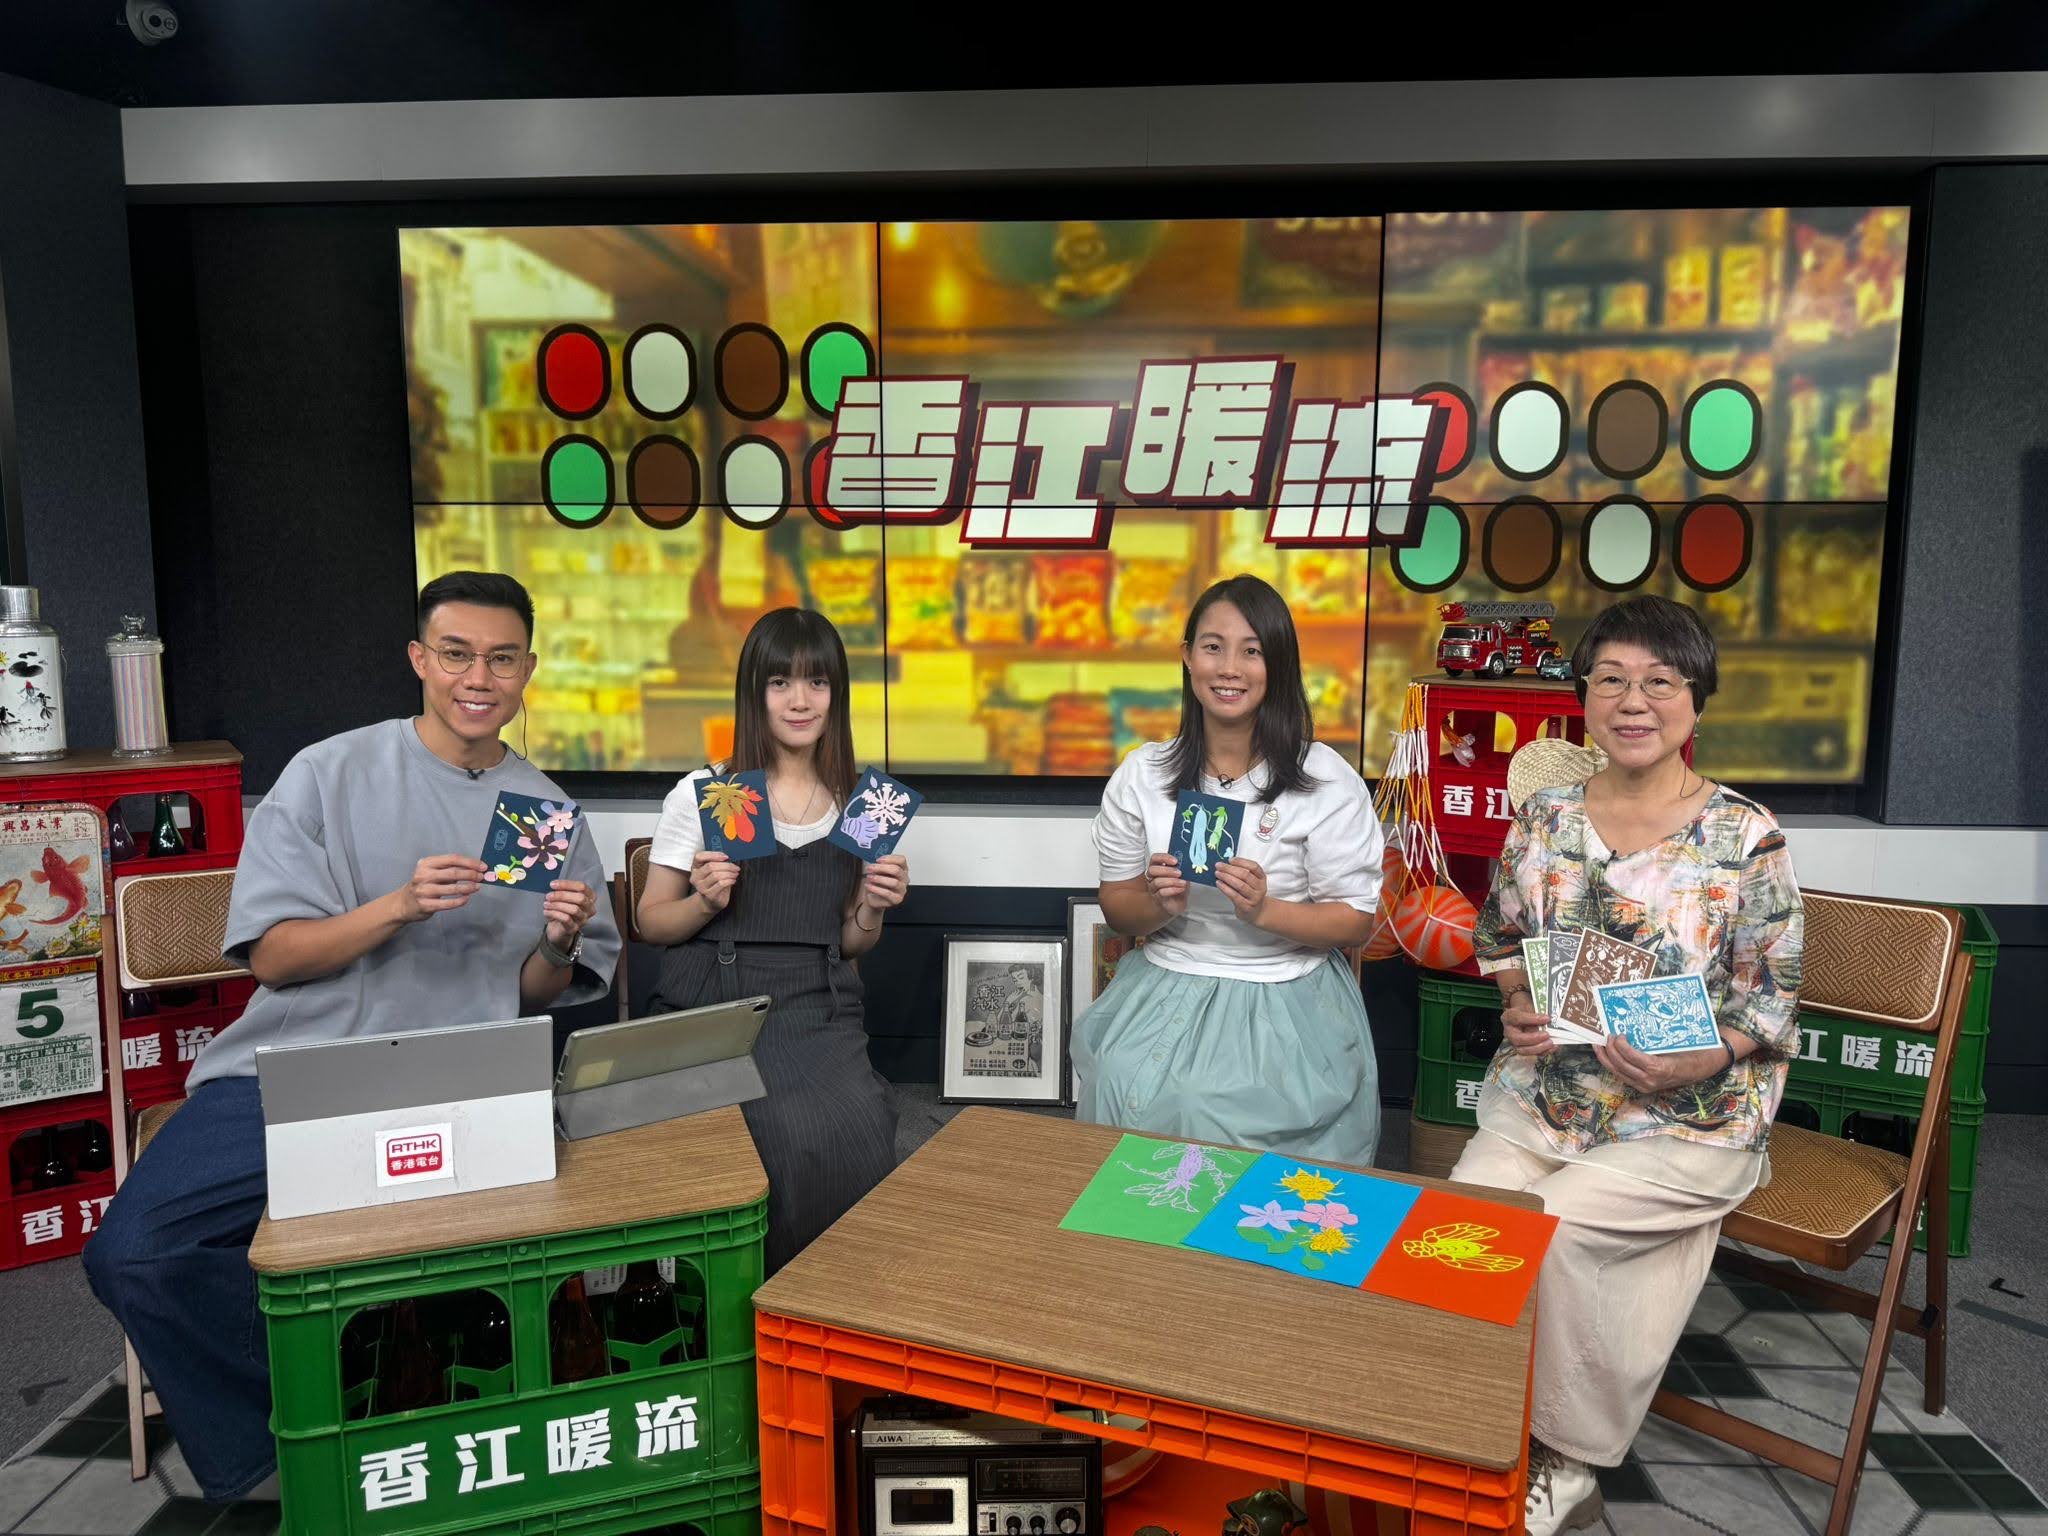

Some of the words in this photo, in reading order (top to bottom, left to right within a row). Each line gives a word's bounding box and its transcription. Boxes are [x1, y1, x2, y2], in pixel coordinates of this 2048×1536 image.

[825, 355, 1445, 548] 香江暖流
[1442, 784, 1515, 820] 香江
[972, 998, 999, 1011] 汽水
[978, 984, 1005, 999] 香江
[16, 988, 64, 1039] 5
[121, 1026, 214, 1070] 暖流
[391, 1139, 437, 1153] RTHK
[391, 1155, 439, 1171] 香港電台
[876, 1435, 903, 1443] AIWA
[360, 1394, 700, 1511] 香江暖流
